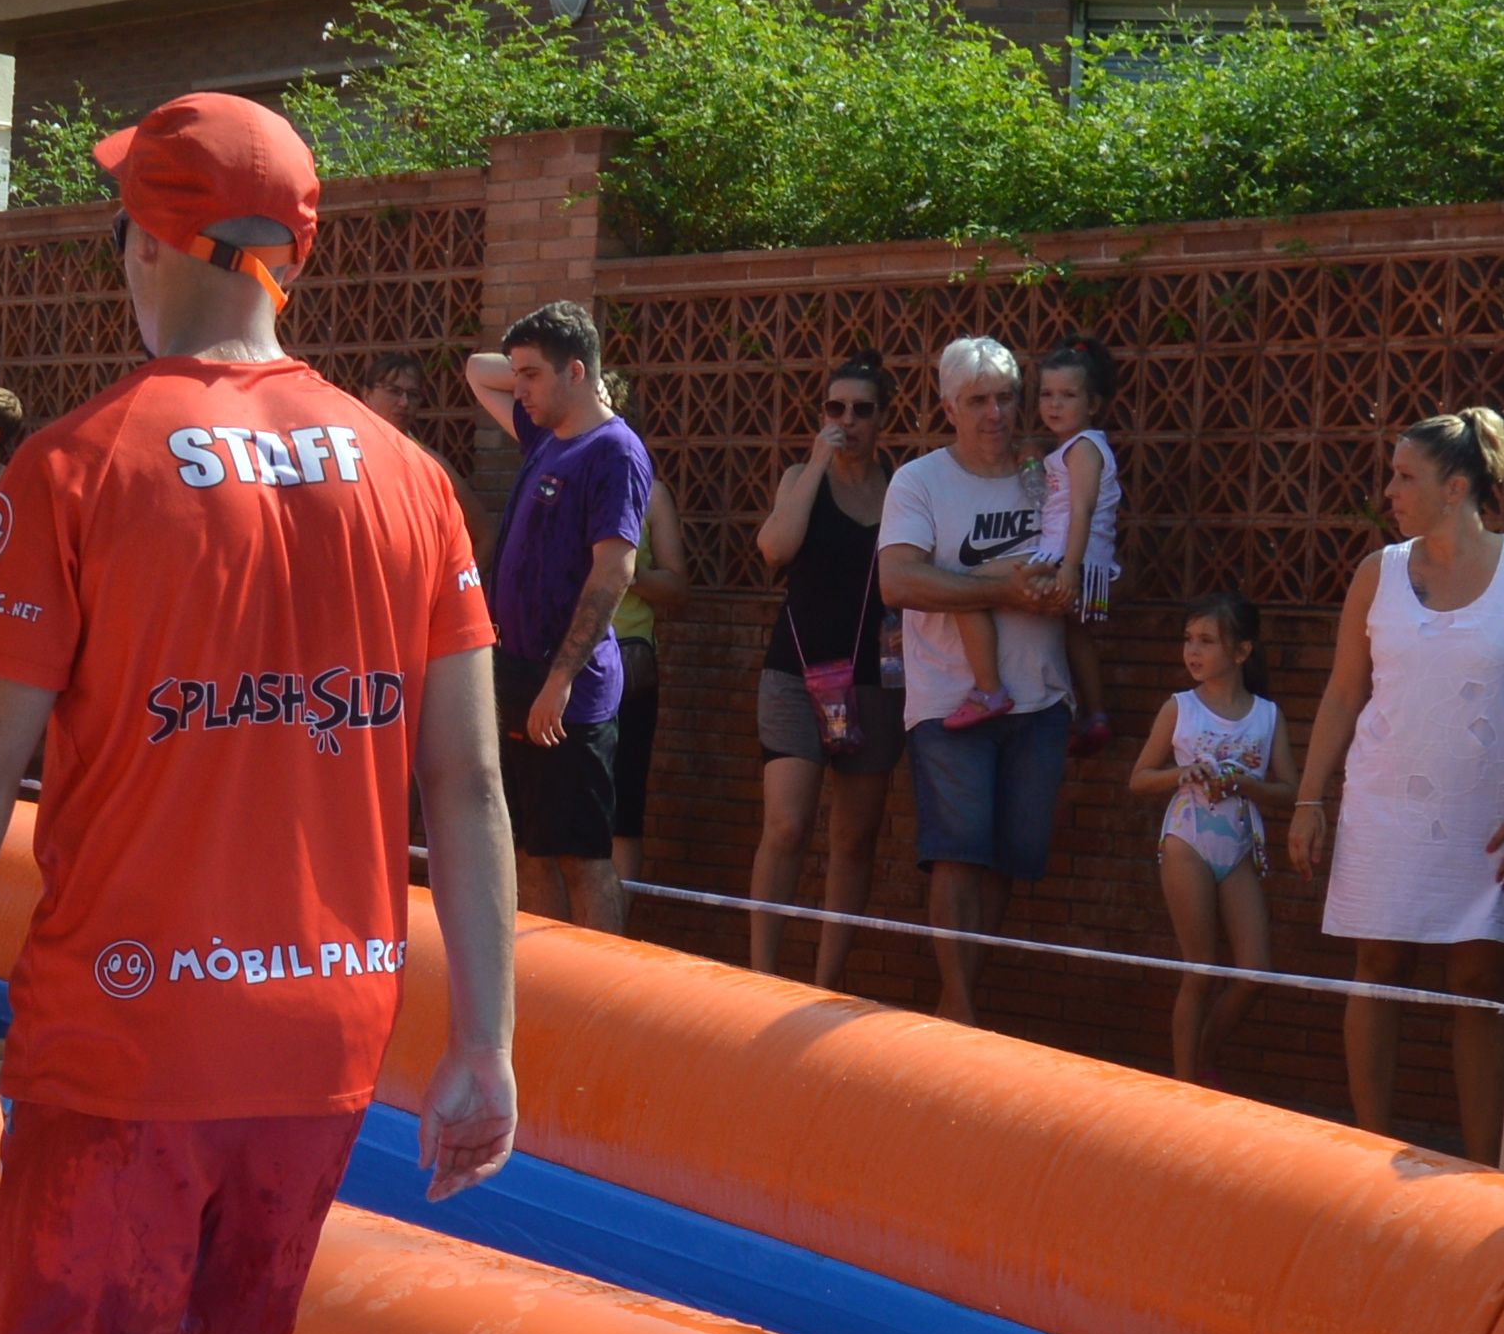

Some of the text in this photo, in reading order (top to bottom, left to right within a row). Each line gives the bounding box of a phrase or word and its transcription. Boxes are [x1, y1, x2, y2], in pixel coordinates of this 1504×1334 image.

[168, 424, 362, 488] STAFF
[972, 509, 1035, 541] NIKE
[168, 935, 314, 985] MÒBIL
